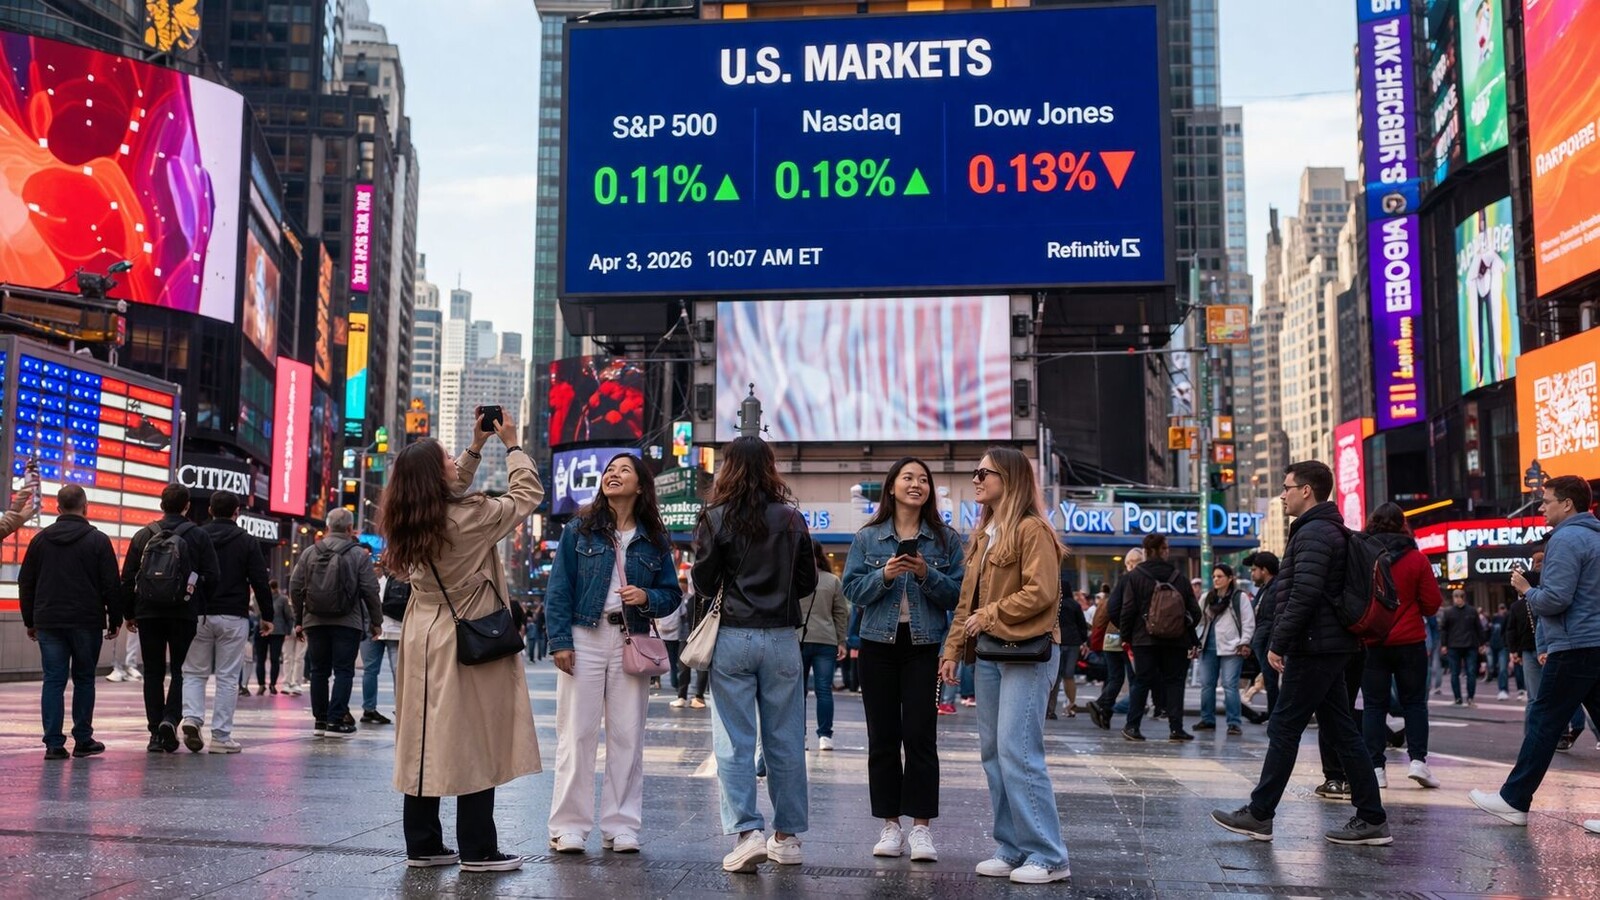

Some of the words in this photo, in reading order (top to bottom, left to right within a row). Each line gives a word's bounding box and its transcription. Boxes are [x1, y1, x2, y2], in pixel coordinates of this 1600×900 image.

[720, 46, 792, 86] U.S.
[804, 38, 992, 82] MARKETS
[612, 114, 666, 139] S&P
[671, 112, 717, 137] 500
[802, 107, 901, 136] Nasdaq
[974, 104, 1032, 127] Dow
[1037, 102, 1114, 125] Jones
[593, 164, 708, 205] 0.11%
[775, 158, 896, 200] 0.18%
[968, 151, 1097, 194] 0.13%
[588, 253, 622, 275] Apr
[625, 252, 642, 272] 3,
[647, 251, 693, 269] 2026
[707, 249, 757, 268] 10:07
[761, 248, 793, 266] AM
[799, 247, 824, 265] ET
[1047, 240, 1121, 259] Refinitiv
[177, 464, 251, 496] CITIZEN
[1060, 501, 1115, 533] YORK
[1123, 502, 1199, 534] POLICE
